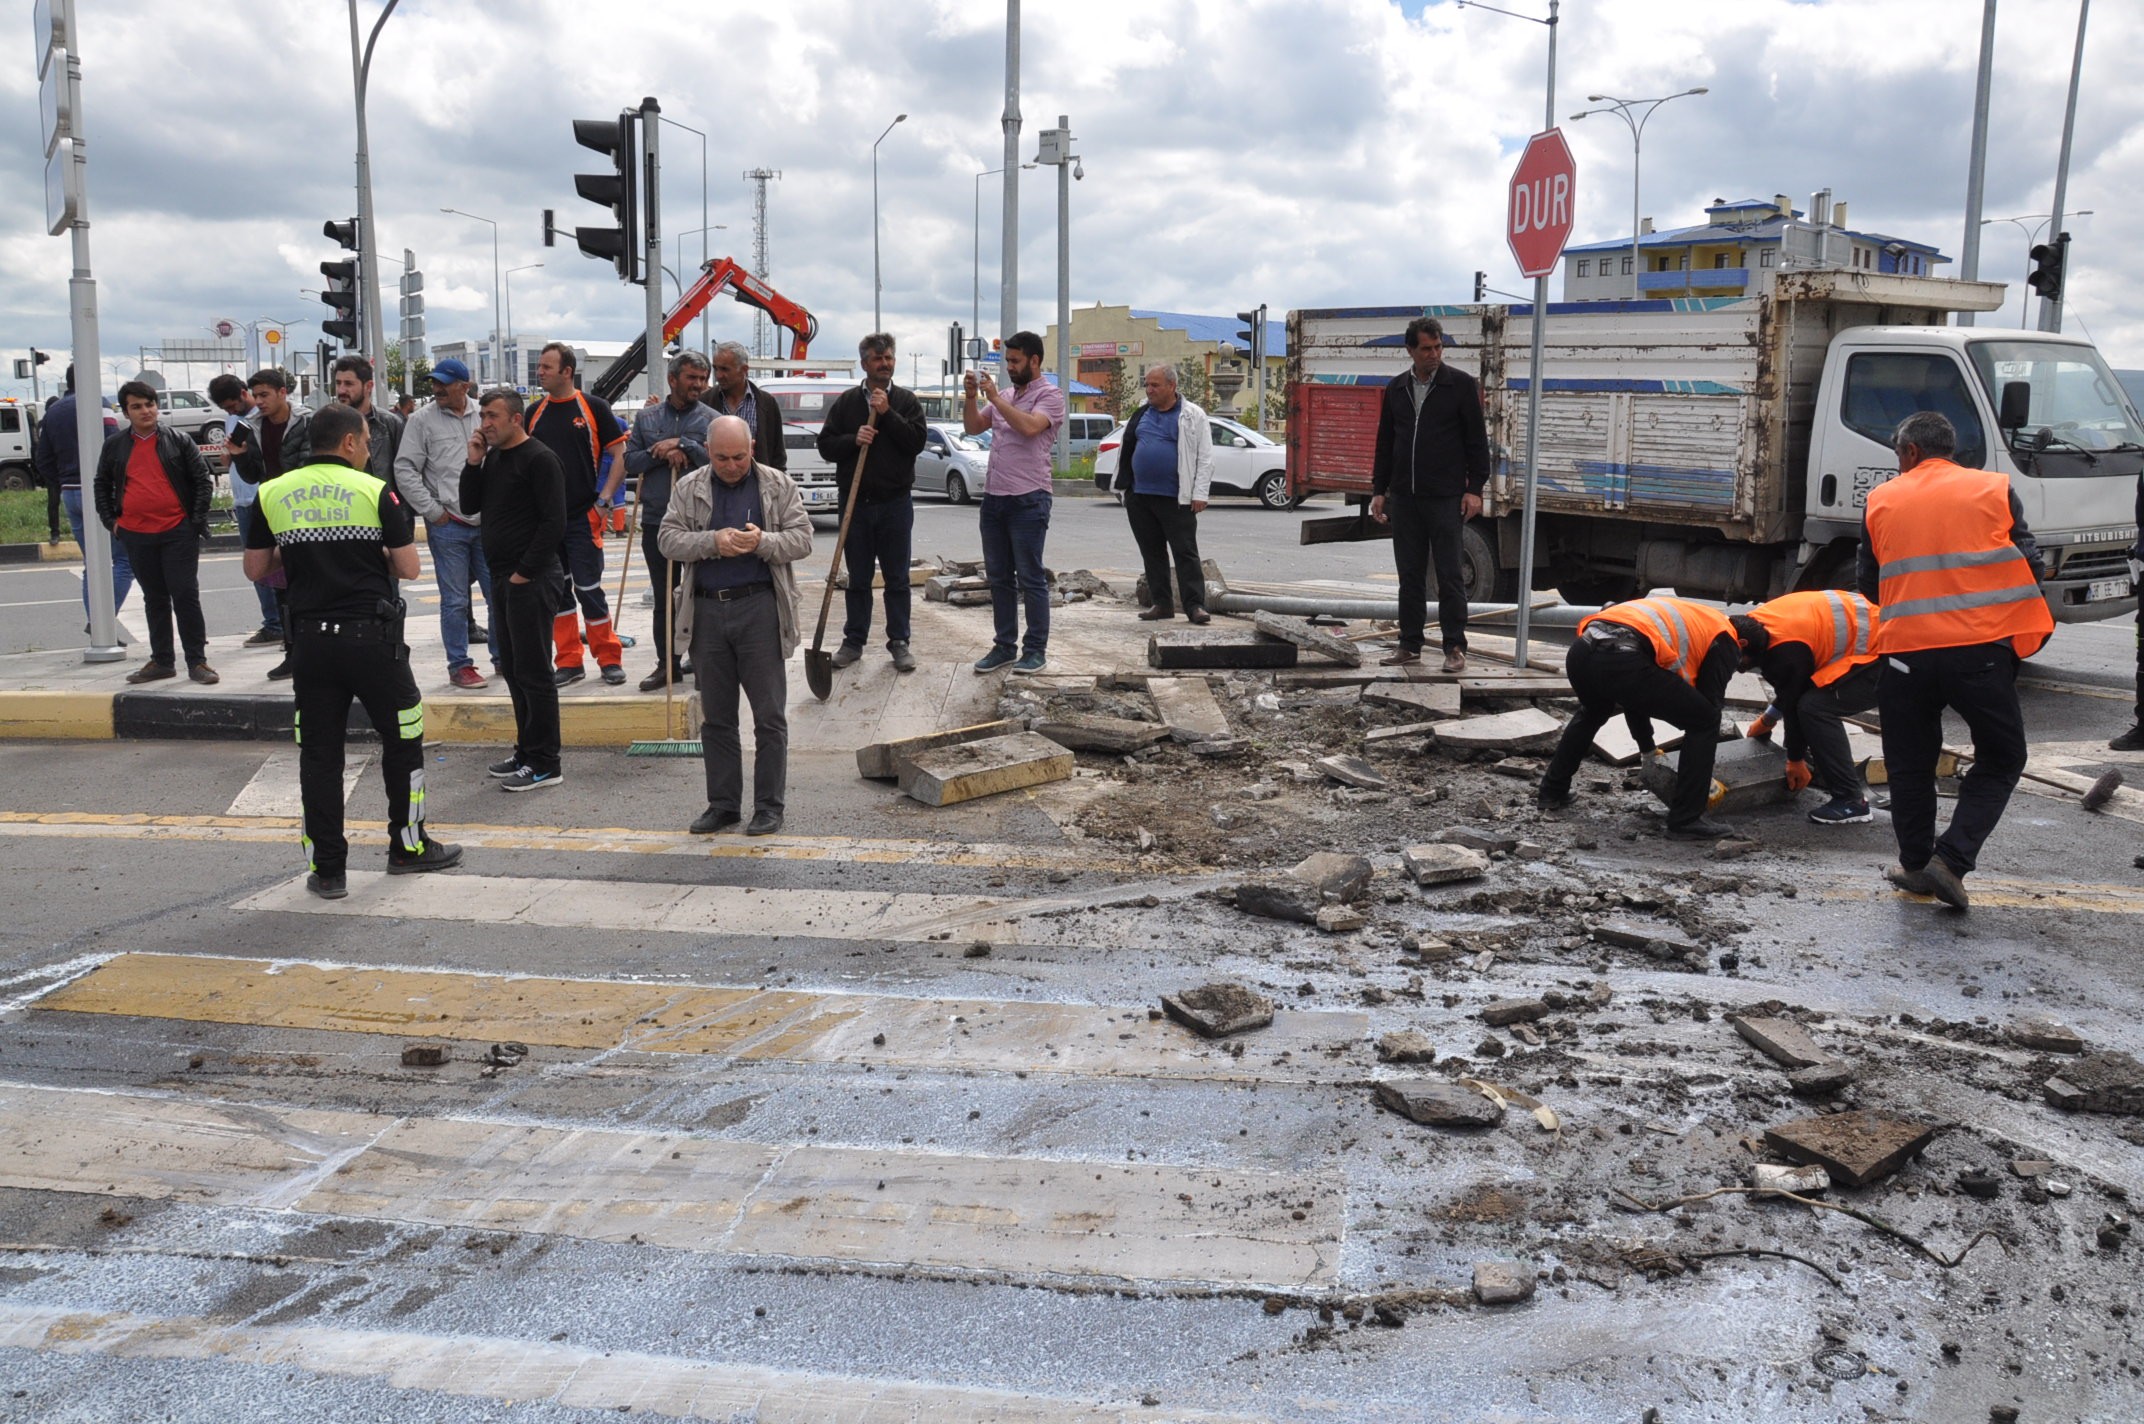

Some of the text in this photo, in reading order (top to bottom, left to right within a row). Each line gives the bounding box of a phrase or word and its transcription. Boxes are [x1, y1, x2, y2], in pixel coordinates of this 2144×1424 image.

[1513, 173, 1569, 234] DUR
[280, 483, 356, 510] TRAFİK
[291, 506, 351, 523] POLİSİ
[2074, 530, 2135, 543] MITSUBISHI
